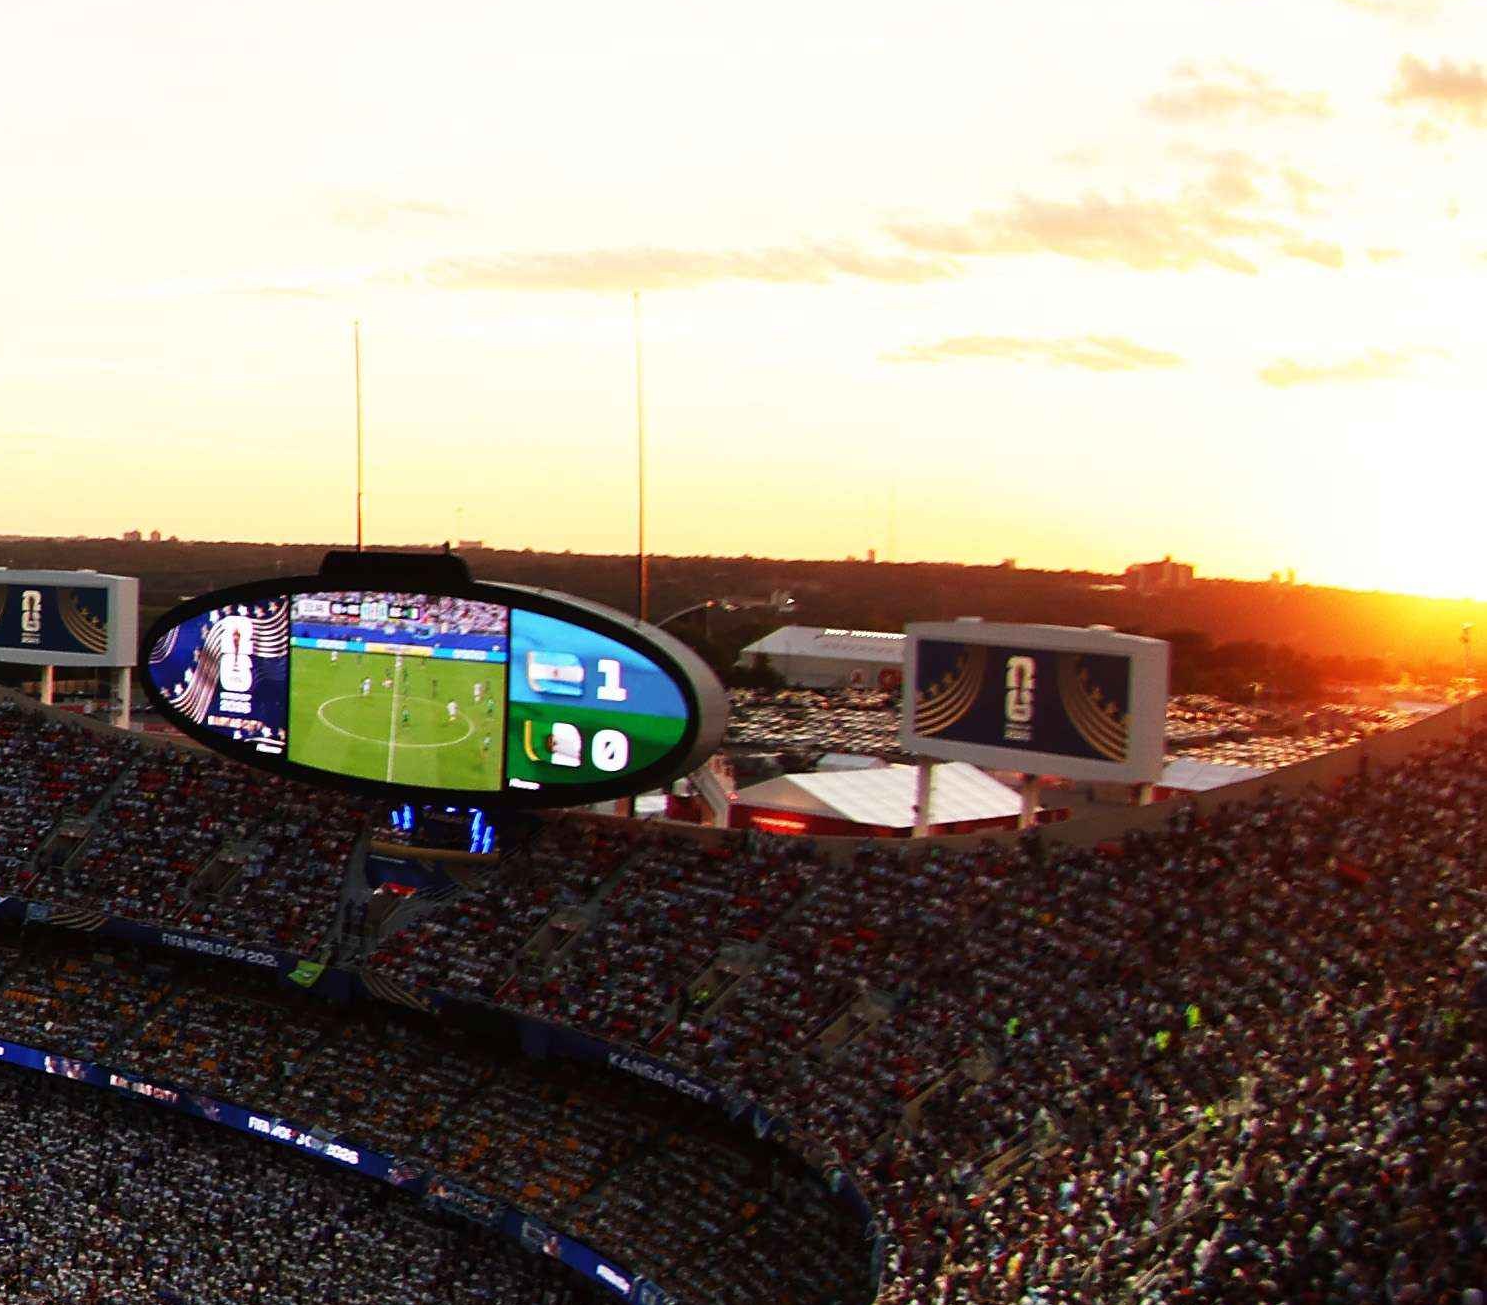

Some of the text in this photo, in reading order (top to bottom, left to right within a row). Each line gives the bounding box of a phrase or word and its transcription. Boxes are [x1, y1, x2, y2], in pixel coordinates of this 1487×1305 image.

[597, 659, 628, 702] 1
[592, 729, 628, 772] 0
[246, 950, 280, 967] 202
